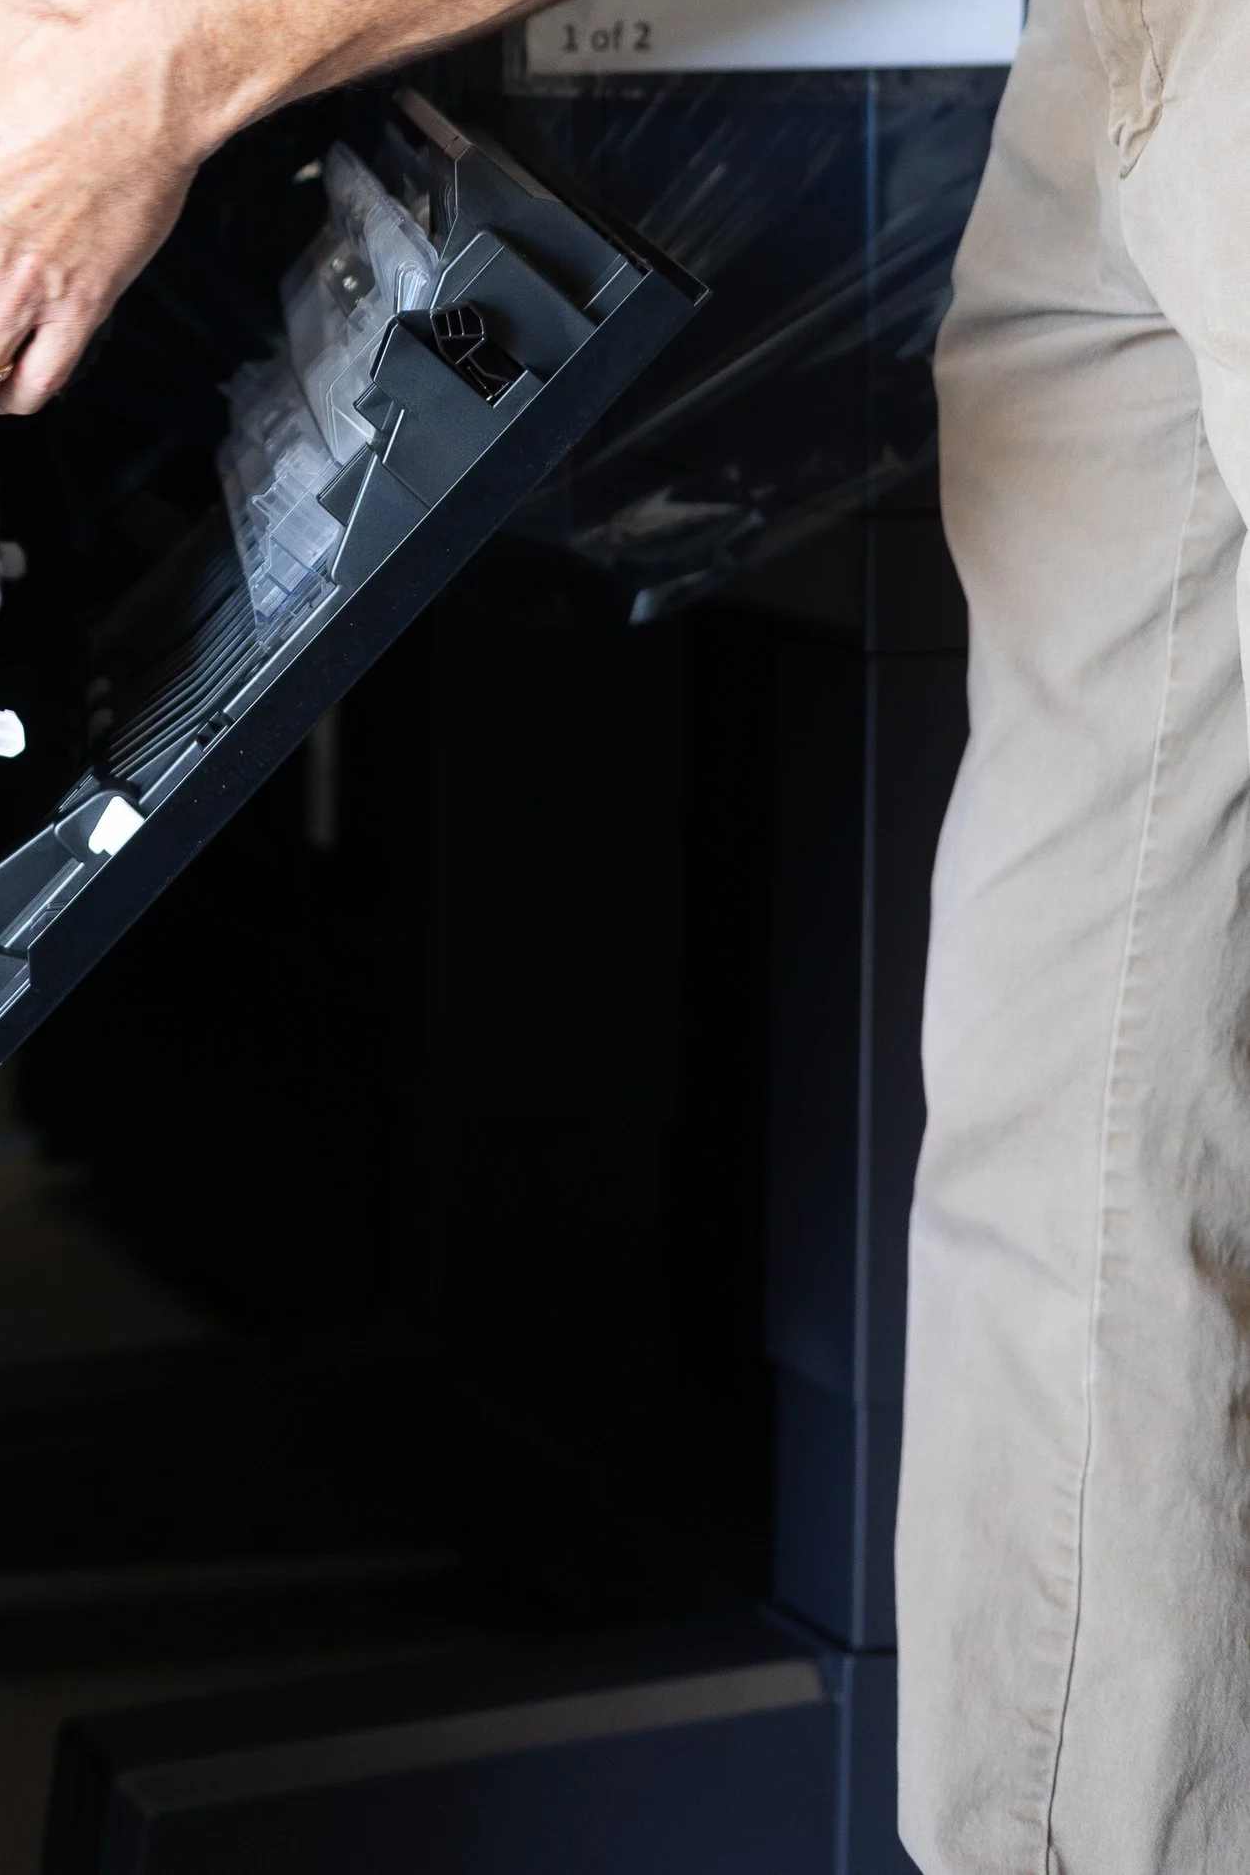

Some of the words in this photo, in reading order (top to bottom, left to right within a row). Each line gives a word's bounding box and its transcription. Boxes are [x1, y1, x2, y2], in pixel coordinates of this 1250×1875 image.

[562, 23, 579, 53] 1
[590, 20, 625, 53] of
[632, 21, 651, 53] 2
